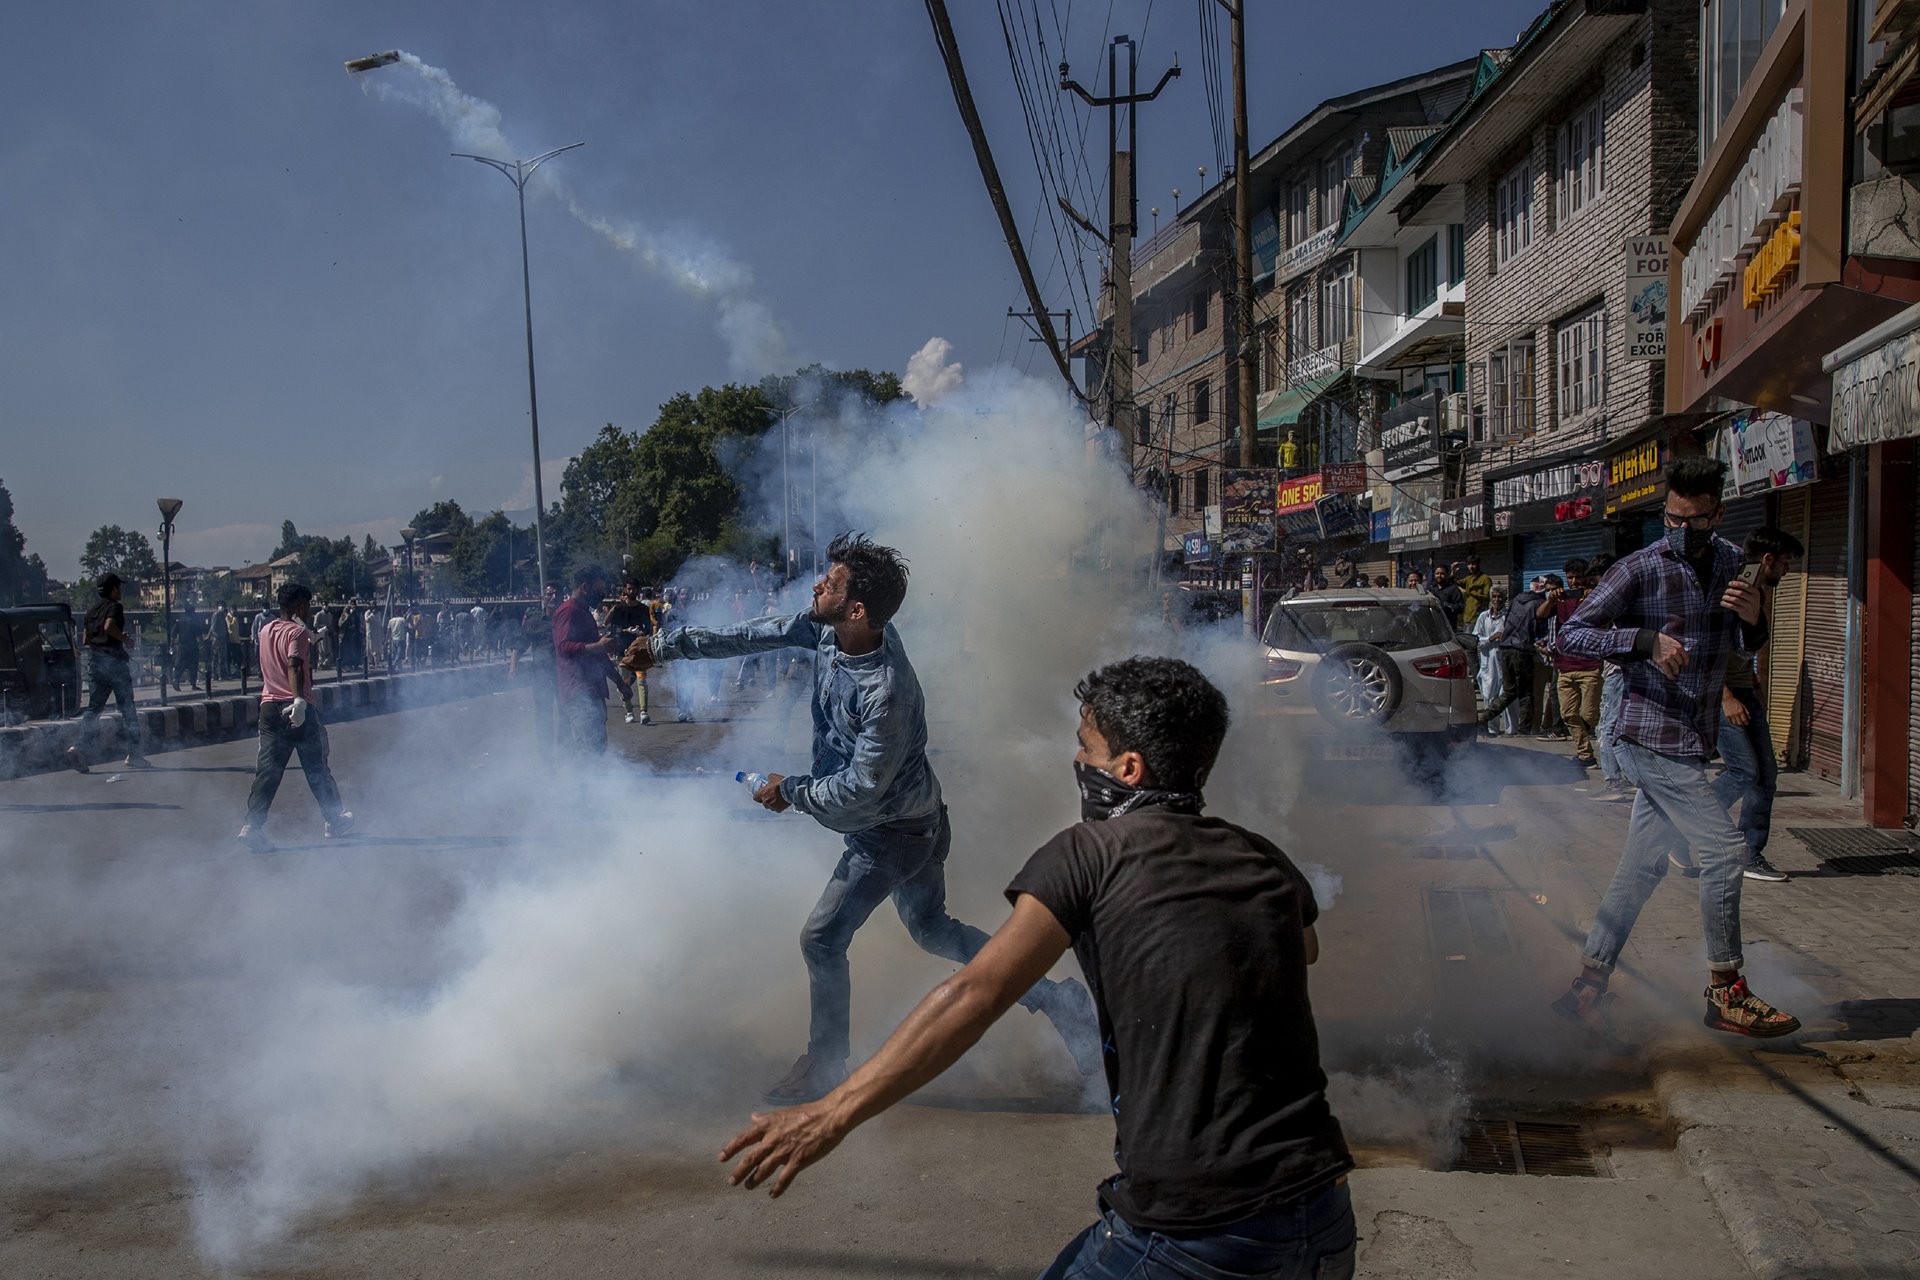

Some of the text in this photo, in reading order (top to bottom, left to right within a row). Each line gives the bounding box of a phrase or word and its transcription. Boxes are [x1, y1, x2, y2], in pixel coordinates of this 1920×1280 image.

[1637, 332, 1666, 343] FOR
[1302, 345, 1339, 374] PRECISION
[1639, 440, 1658, 474] KID
[1326, 466, 1362, 475] HOTEL
[1325, 480, 1364, 488] SEASON
[1413, 520, 1430, 537] SPORTS
